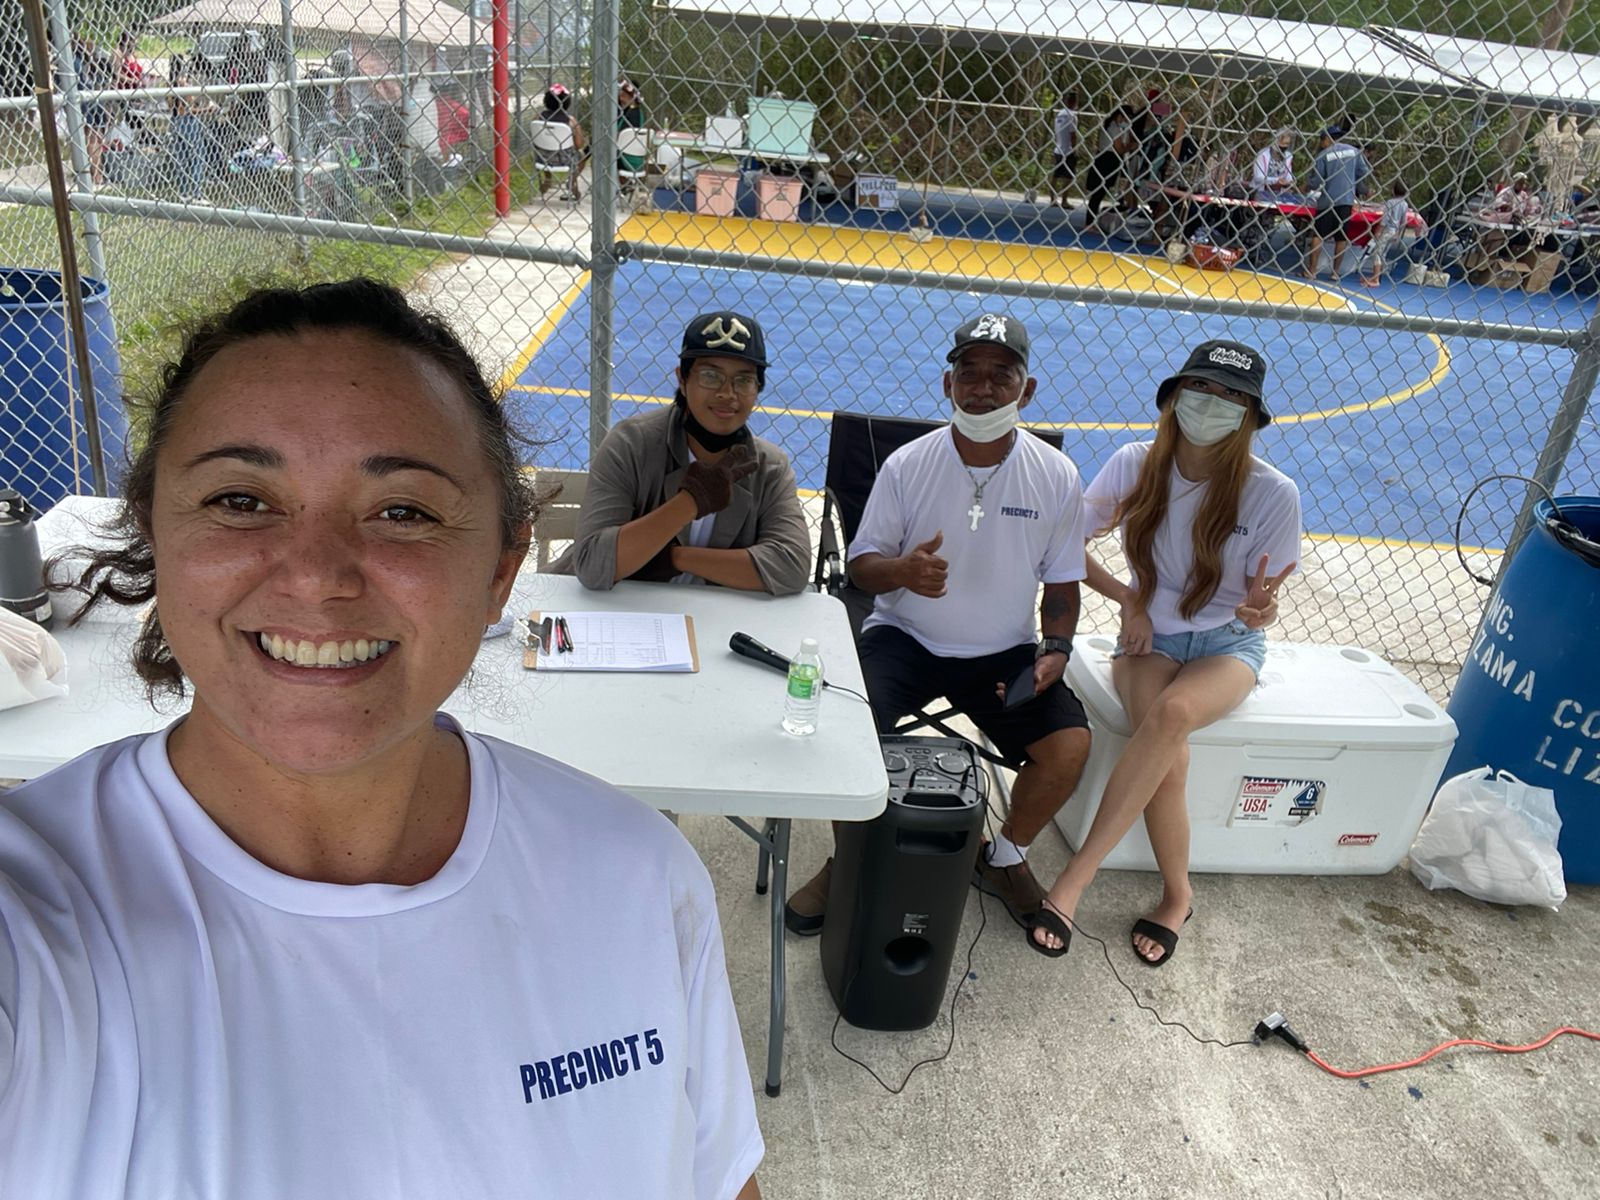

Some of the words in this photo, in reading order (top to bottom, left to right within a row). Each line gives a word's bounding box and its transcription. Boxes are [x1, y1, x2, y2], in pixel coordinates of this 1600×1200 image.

[1000, 506, 1033, 519] PRECINCT
[1034, 510, 1039, 520] 5
[1306, 787, 1315, 800] 6
[1243, 799, 1268, 812] USA
[519, 1034, 641, 1104] PRECINCT
[643, 1028, 664, 1066] 5
